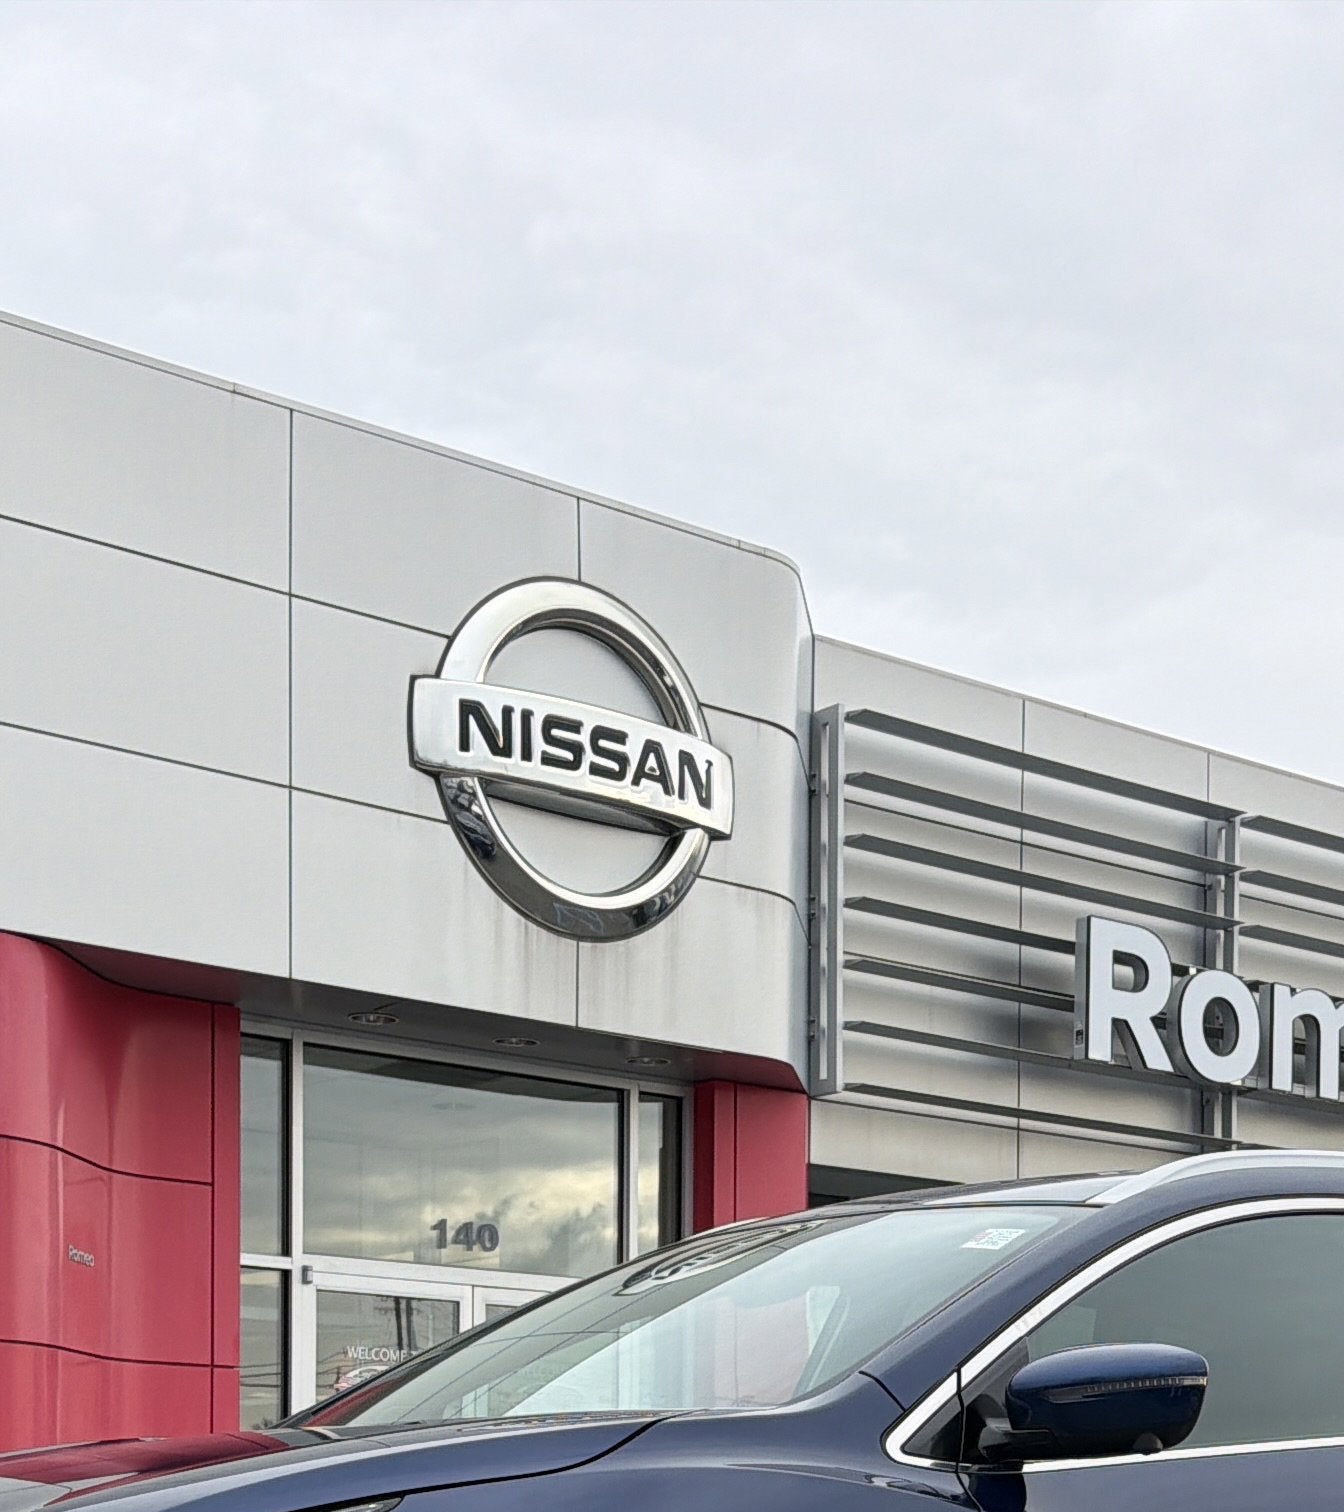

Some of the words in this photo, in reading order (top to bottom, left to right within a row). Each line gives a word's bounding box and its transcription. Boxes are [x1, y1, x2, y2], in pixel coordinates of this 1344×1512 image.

[457, 697, 713, 811] NISSAN
[430, 1218, 499, 1252] 140
[68, 1244, 95, 1267] Romeo
[346, 1345, 407, 1363] WELCOME
